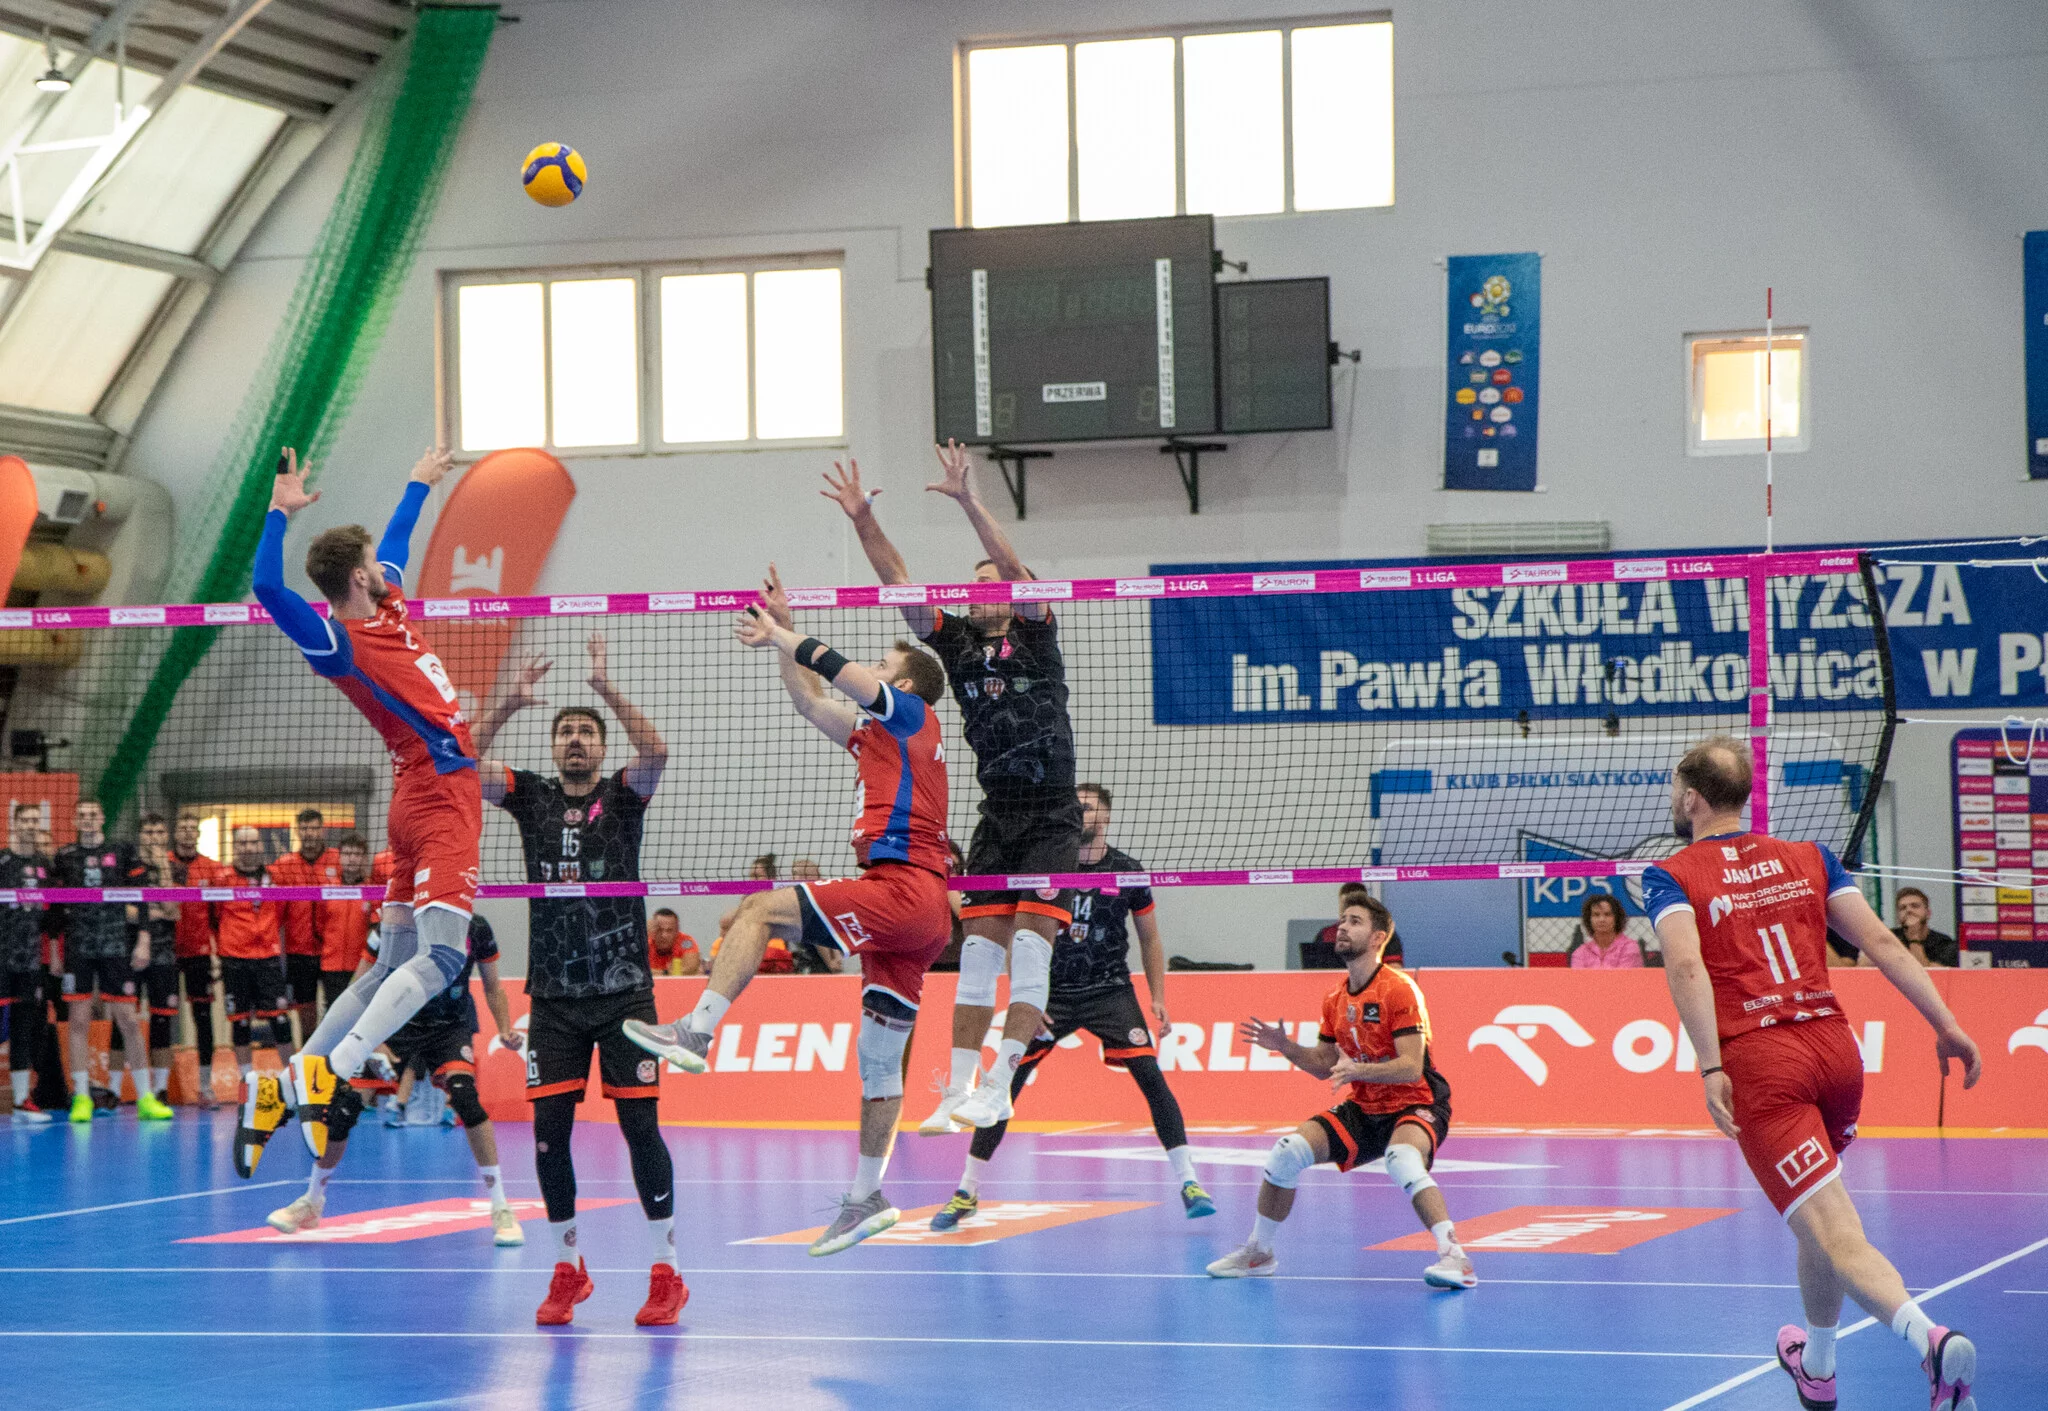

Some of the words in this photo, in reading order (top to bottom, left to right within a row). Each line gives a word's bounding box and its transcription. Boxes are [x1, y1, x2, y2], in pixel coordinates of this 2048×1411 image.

[1820, 556, 1854, 567] netex
[1524, 569, 1561, 578] TAURON
[1681, 562, 1715, 574] LIGA
[1273, 578, 1309, 587] TAURON
[1377, 575, 1408, 583] TAURON
[1425, 572, 1456, 583] LIGA
[1031, 585, 1067, 594] TAURON
[1178, 581, 1208, 591] LIGA
[798, 592, 831, 602] TAURON
[939, 588, 969, 599] LIGA
[569, 600, 602, 609] TAURON
[708, 595, 736, 606] LIGA
[483, 601, 510, 613] LIGA
[44, 612, 71, 624] LIGA
[1320, 647, 1500, 711] Pawła
[1922, 648, 1978, 697] w
[1446, 774, 1499, 790] KLUB
[562, 827, 581, 857] 16
[1408, 870, 1429, 878] LIGA
[1721, 858, 1785, 885] JANZEN
[1732, 878, 1810, 901] NAFTOREMONT
[1734, 887, 1815, 910] NAFTOBUDOWA
[1074, 895, 1092, 921] 14
[1757, 923, 1801, 985] 11
